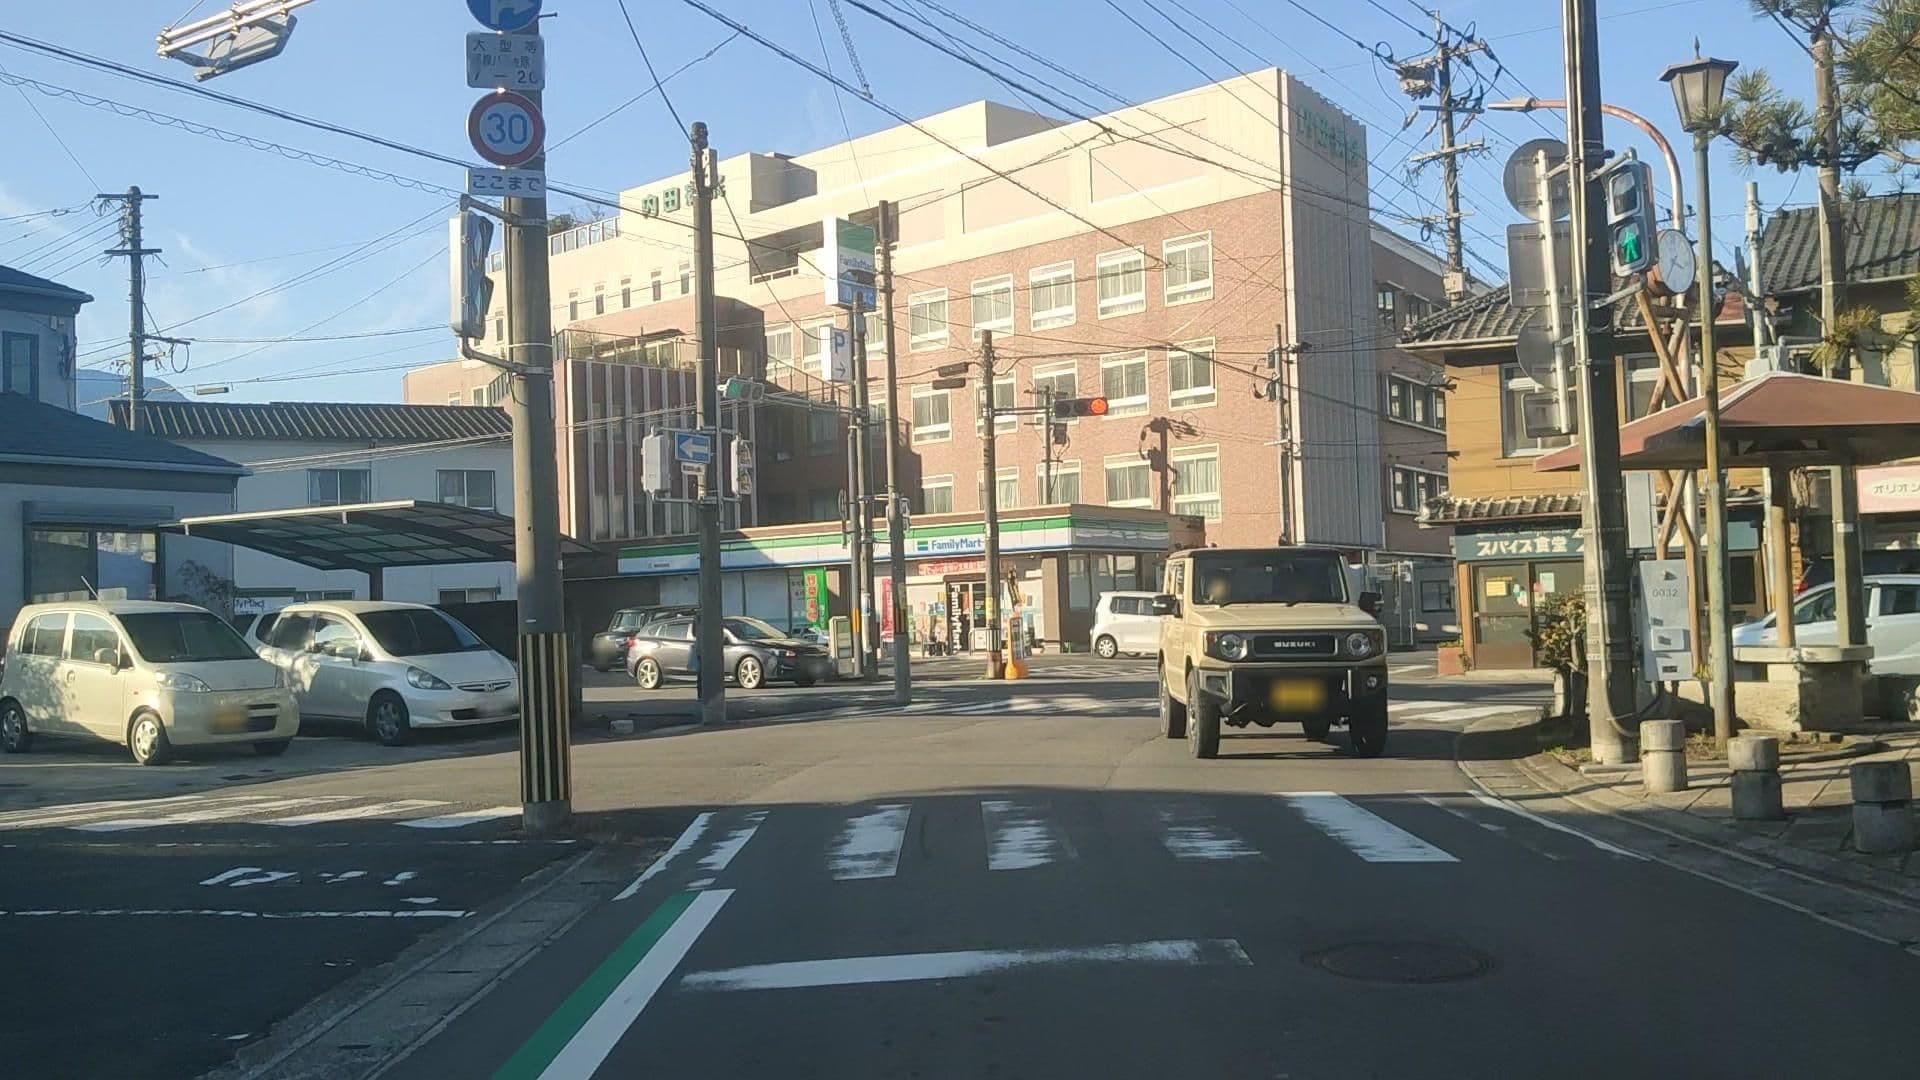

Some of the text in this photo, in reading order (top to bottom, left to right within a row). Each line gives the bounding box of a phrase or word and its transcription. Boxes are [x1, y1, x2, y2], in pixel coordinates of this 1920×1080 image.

[486, 112, 528, 145] 30
[472, 173, 541, 191] ここまで
[833, 332, 845, 354] P
[931, 537, 982, 551] FamilyMart
[1477, 536, 1568, 556] スパイス食堂
[1652, 588, 1679, 598] 0032
[951, 584, 963, 653] FamilyMart
